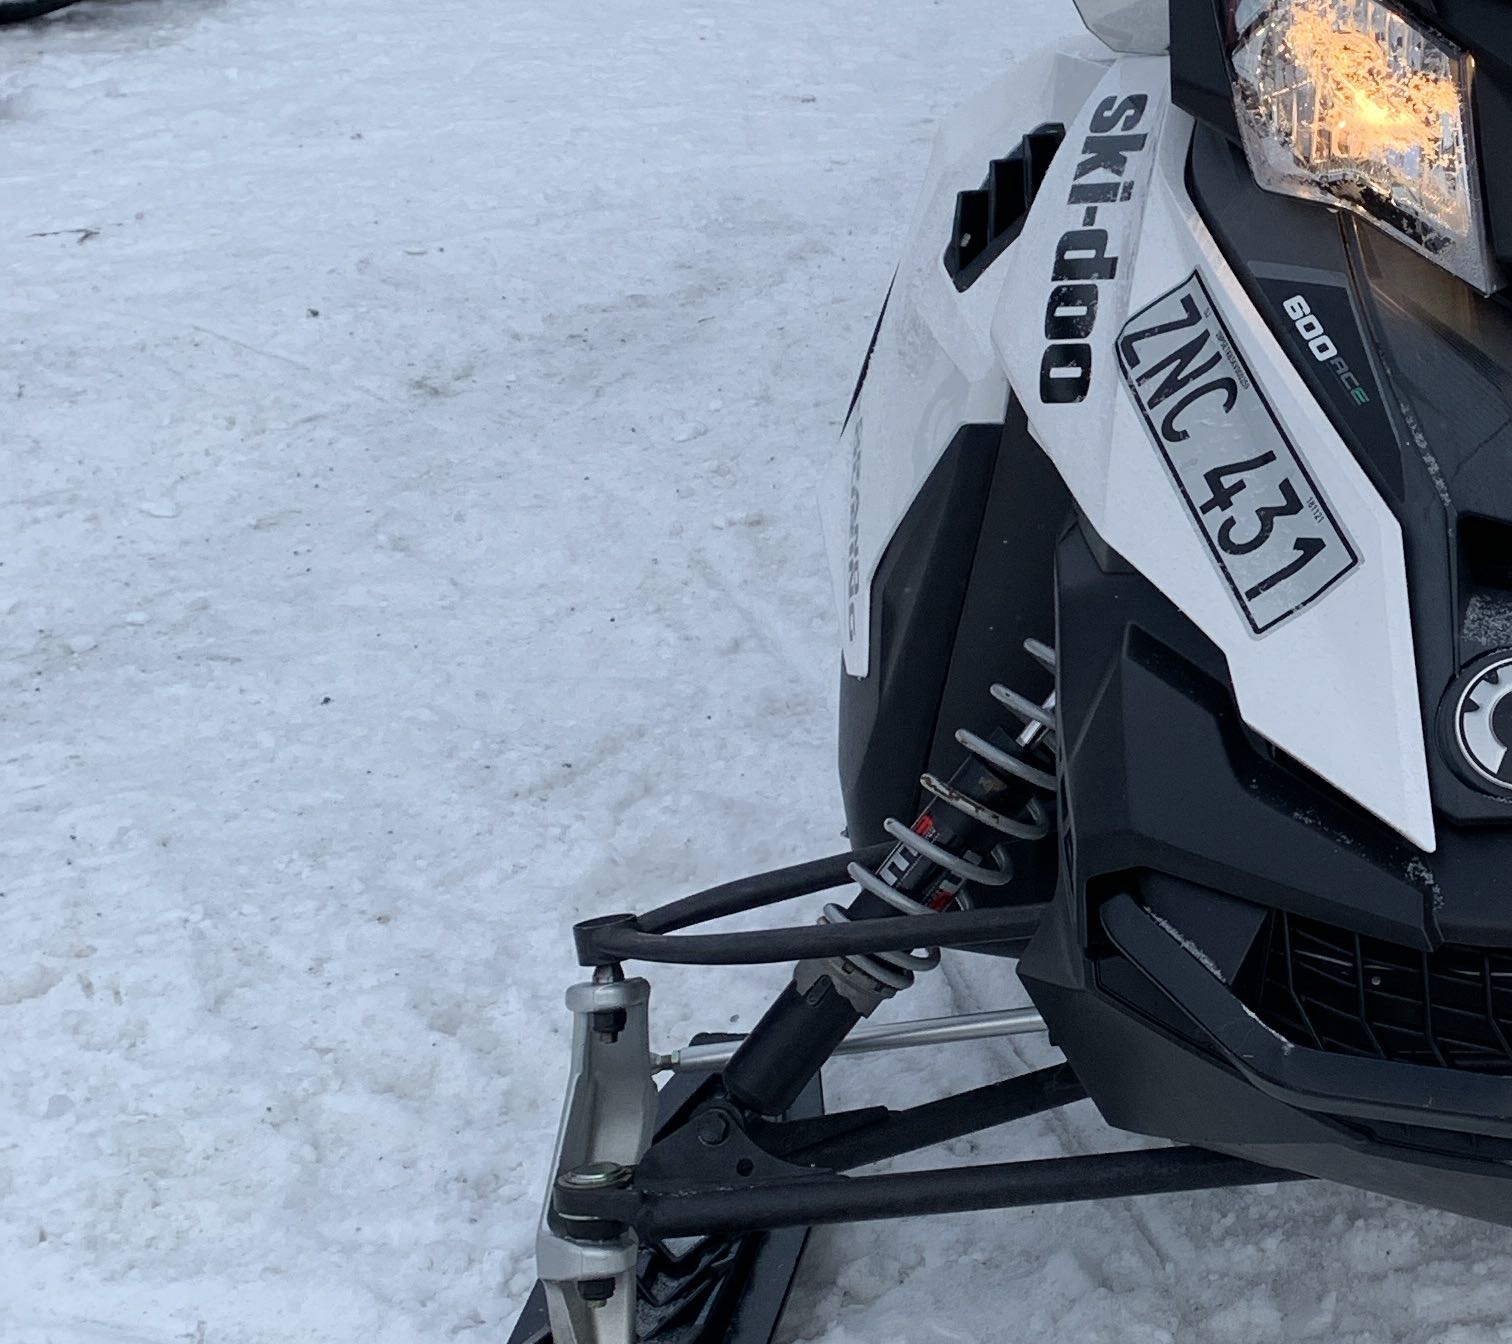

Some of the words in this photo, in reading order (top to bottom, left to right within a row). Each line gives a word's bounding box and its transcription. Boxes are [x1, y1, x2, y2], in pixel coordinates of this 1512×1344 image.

[1040, 94, 1149, 404] ski-doo
[1282, 294, 1338, 362] 600
[1329, 356, 1371, 405] ACE
[1120, 293, 1239, 444] ZNC
[1199, 449, 1327, 602] 431
